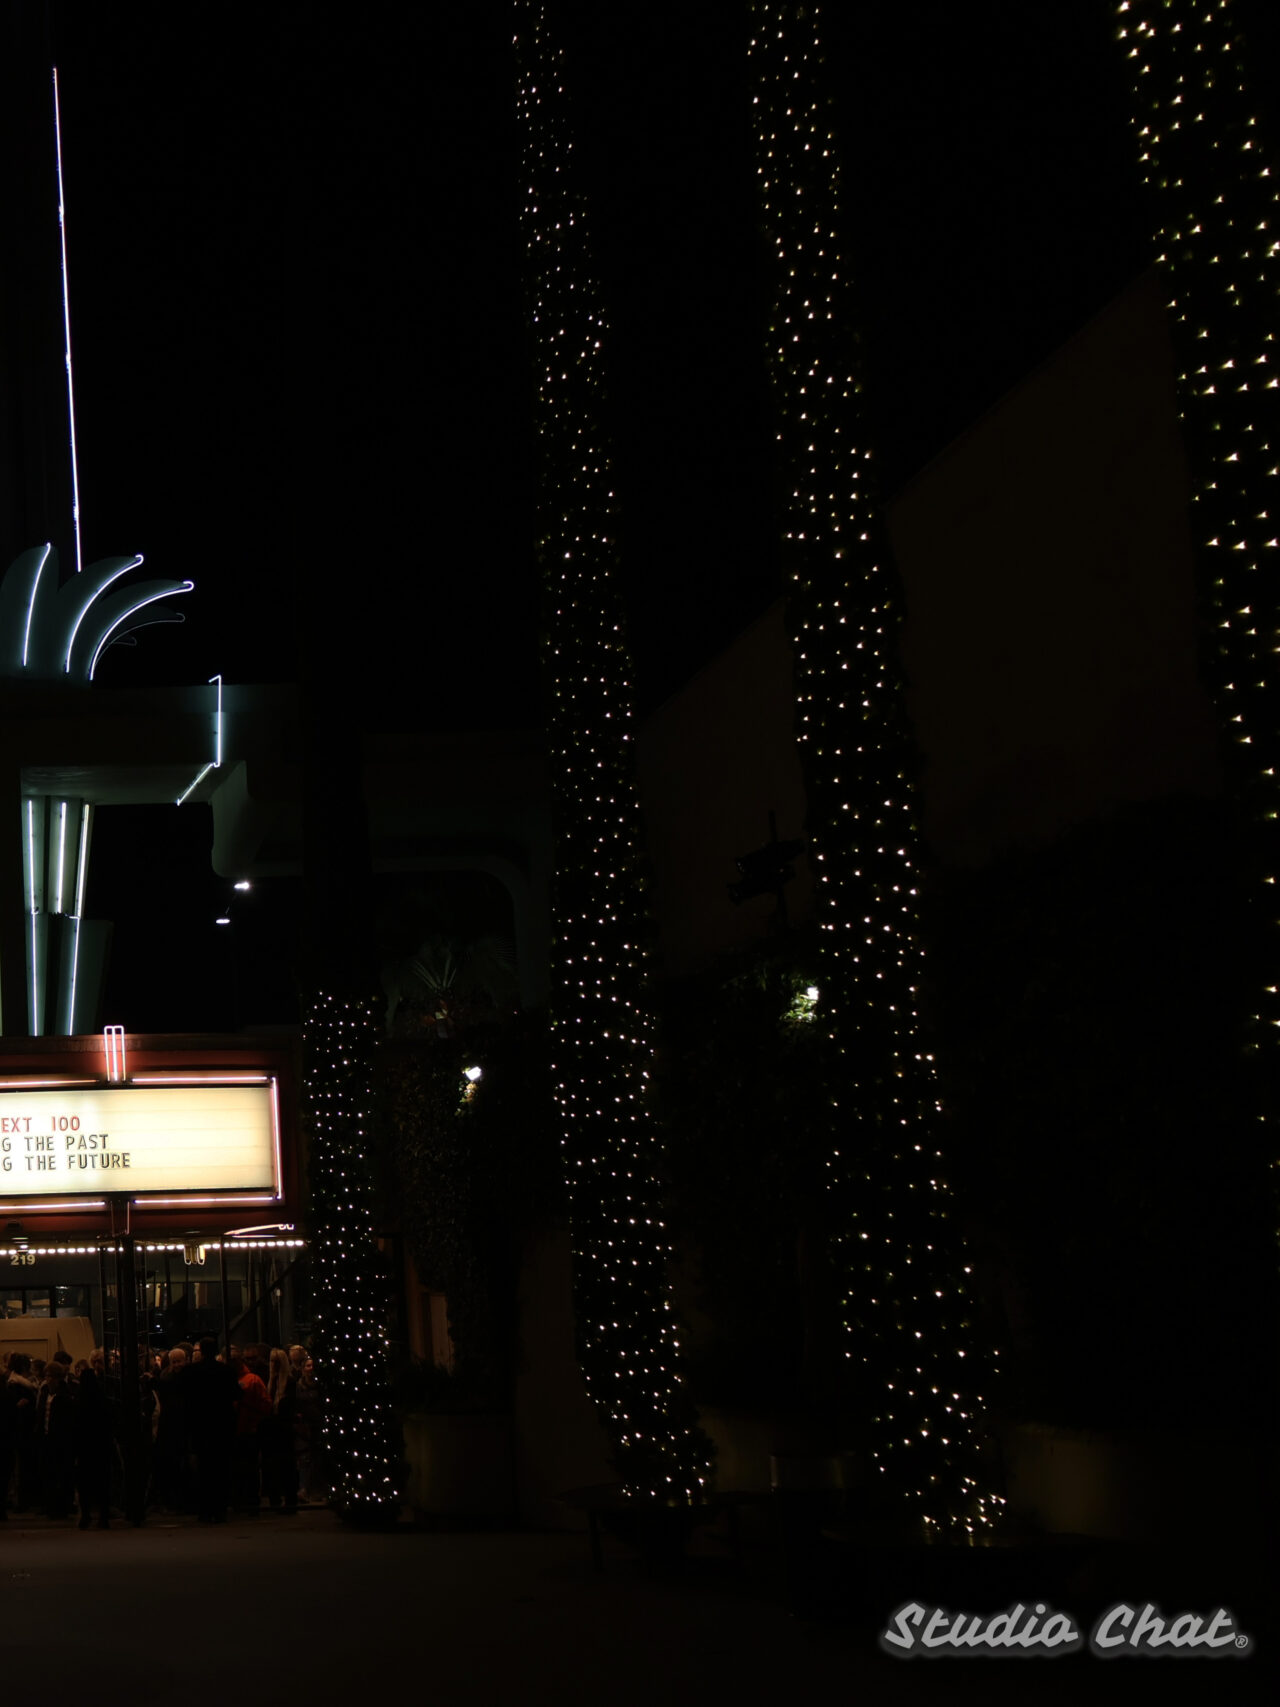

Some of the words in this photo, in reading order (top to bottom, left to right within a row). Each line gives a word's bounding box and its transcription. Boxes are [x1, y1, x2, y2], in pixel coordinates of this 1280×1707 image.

[51, 1115, 81, 1132] 100
[24, 1135, 55, 1152] THE
[66, 1133, 109, 1151] PAST
[24, 1154, 57, 1171] THE
[67, 1152, 131, 1170] FUTURE
[10, 1254, 36, 1266] 219
